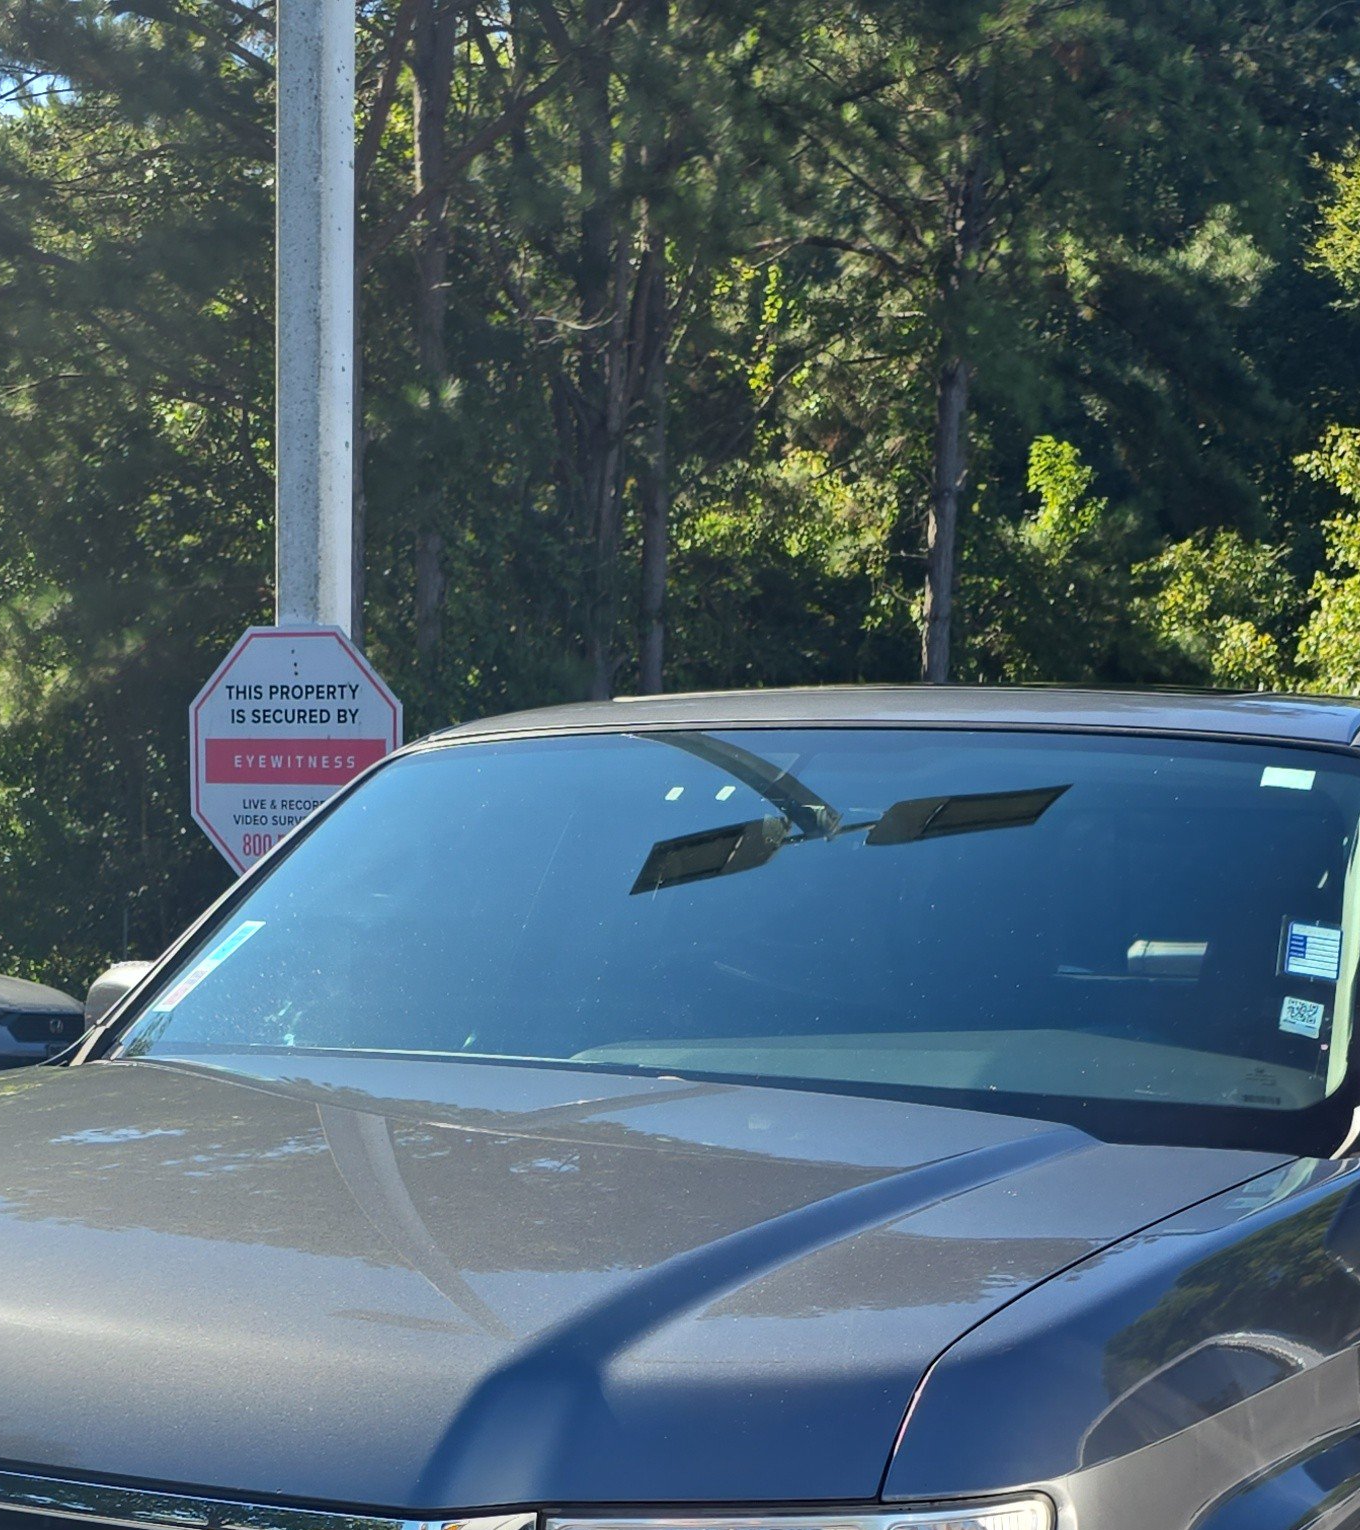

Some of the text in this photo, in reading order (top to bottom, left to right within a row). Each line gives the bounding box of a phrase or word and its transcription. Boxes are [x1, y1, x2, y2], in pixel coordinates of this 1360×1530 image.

[225, 684, 360, 700] THIS PROPERTY
[231, 709, 360, 724] IS SECURED BY
[234, 755, 356, 769] EYEWITNESS
[242, 799, 266, 809] LIVE
[270, 799, 277, 809] &
[233, 814, 306, 826] VIDEO SURV
